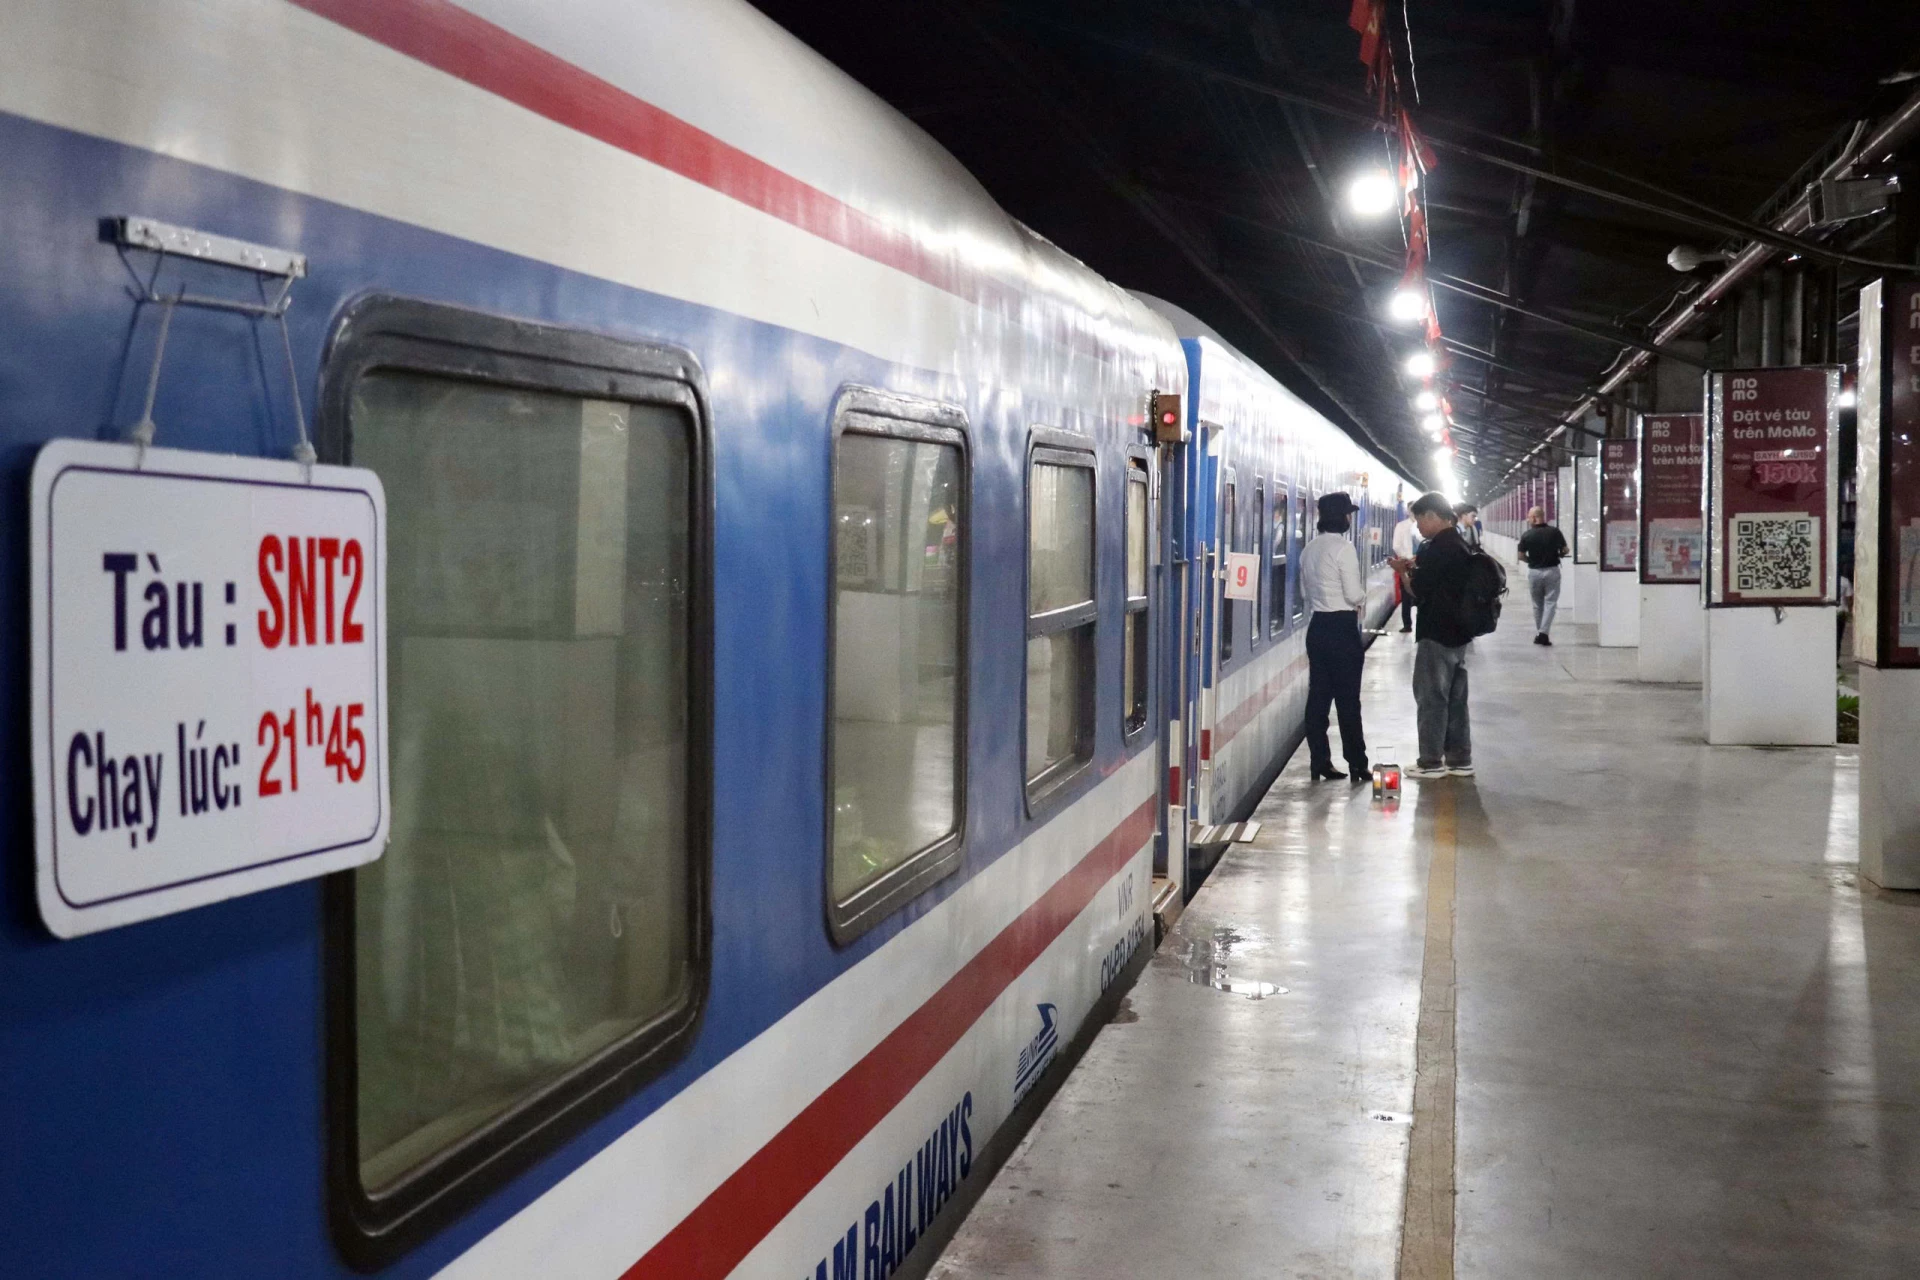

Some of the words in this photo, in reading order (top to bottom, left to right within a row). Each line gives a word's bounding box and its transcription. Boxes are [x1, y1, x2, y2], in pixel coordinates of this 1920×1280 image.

[1733, 410, 1761, 425] Đặt
[1764, 409, 1782, 421] vé
[1785, 408, 1811, 421] tàu
[1733, 426, 1764, 439] trên
[1768, 426, 1817, 438] MoMo
[1677, 455, 1704, 465] MoM
[103, 553, 203, 652] Tàu
[257, 534, 364, 649] SNT2
[1237, 565, 1248, 587] 9
[67, 731, 162, 849] Chạy
[178, 720, 241, 818] lúc:
[1117, 872, 1133, 921] VNR
[865, 1090, 972, 1280] RAILWAYS
